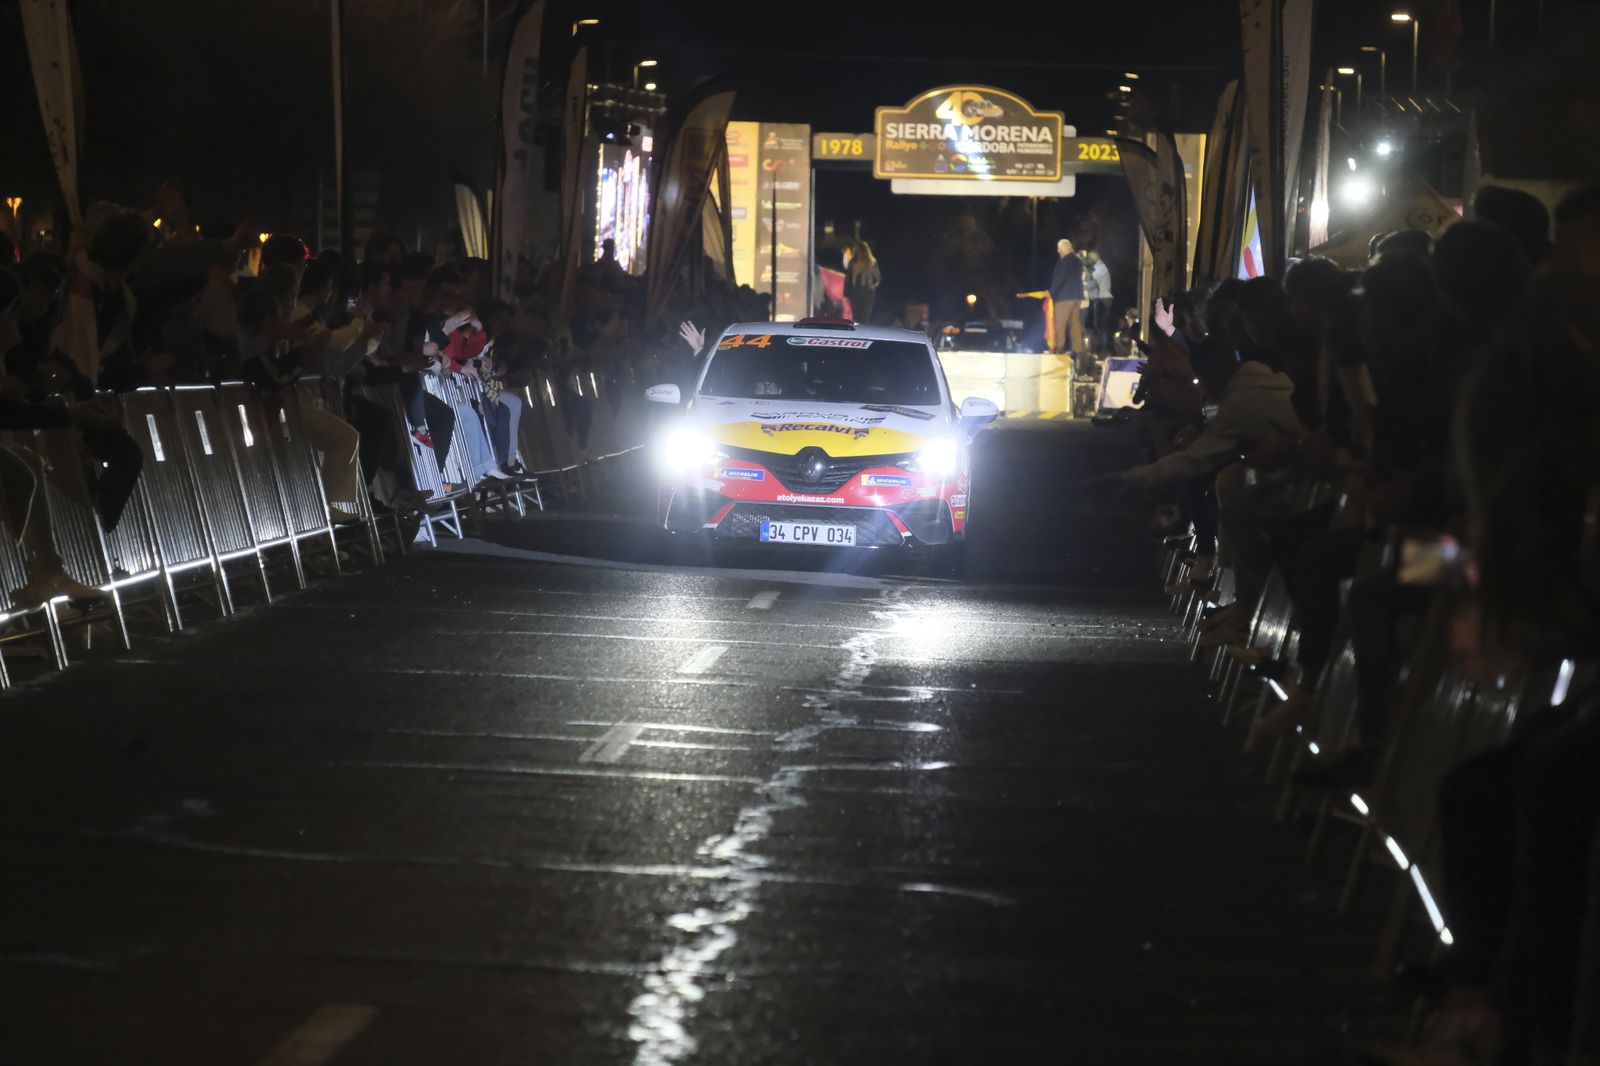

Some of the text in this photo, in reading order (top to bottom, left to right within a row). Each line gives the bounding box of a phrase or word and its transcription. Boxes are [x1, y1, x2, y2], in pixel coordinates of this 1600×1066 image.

[885, 122, 1053, 142] SIERRA MORENA
[821, 139, 863, 156] 1978
[885, 140, 918, 152] Rallye
[1078, 143, 1120, 161] 2023
[720, 334, 772, 348] 44
[807, 338, 869, 348] Castrol
[780, 423, 853, 435] Recalvi
[728, 470, 759, 478] MICHELIN
[777, 494, 845, 504] atolyekazaz.com
[769, 524, 852, 543] 34 CPV 034
